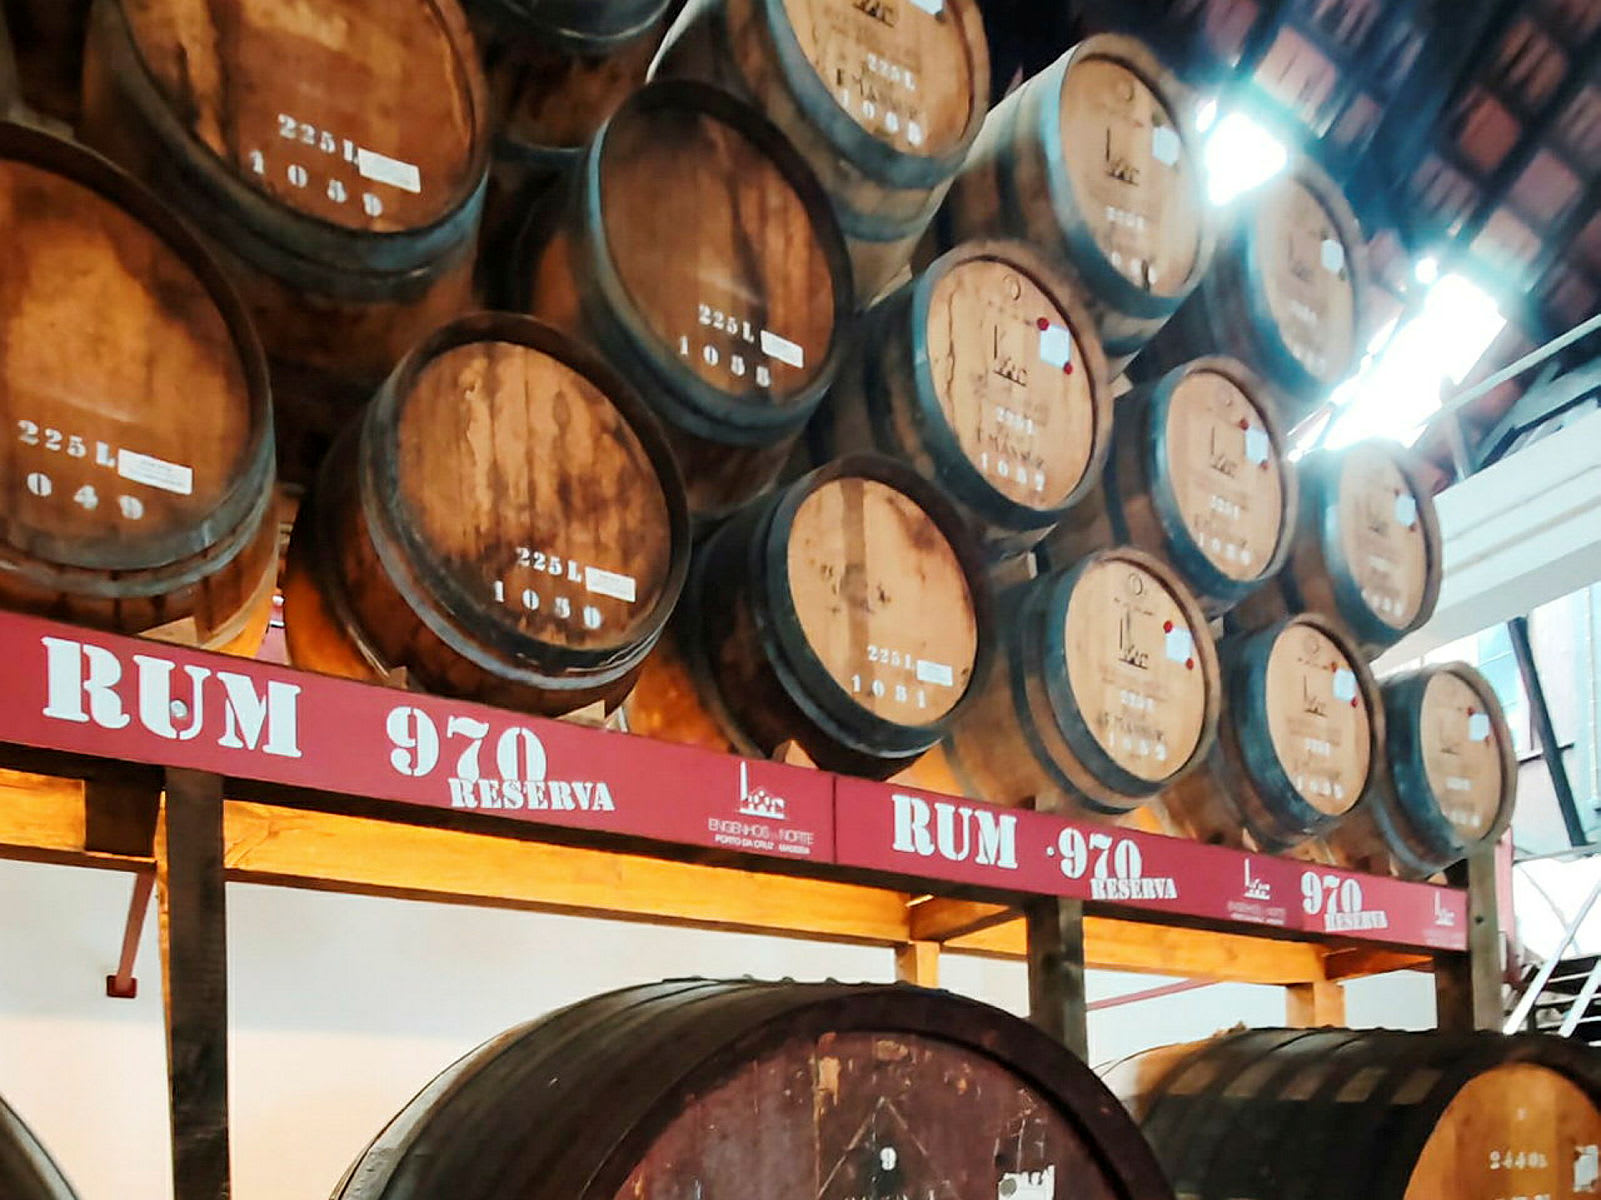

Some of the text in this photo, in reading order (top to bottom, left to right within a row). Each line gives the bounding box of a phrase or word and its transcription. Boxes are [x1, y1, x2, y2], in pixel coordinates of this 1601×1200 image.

[41, 636, 547, 783] RUM 970
[447, 777, 615, 812] RESERVA
[892, 794, 1143, 880] RUM 970
[1091, 877, 1178, 900] RESERVA
[1301, 871, 1363, 916] 970
